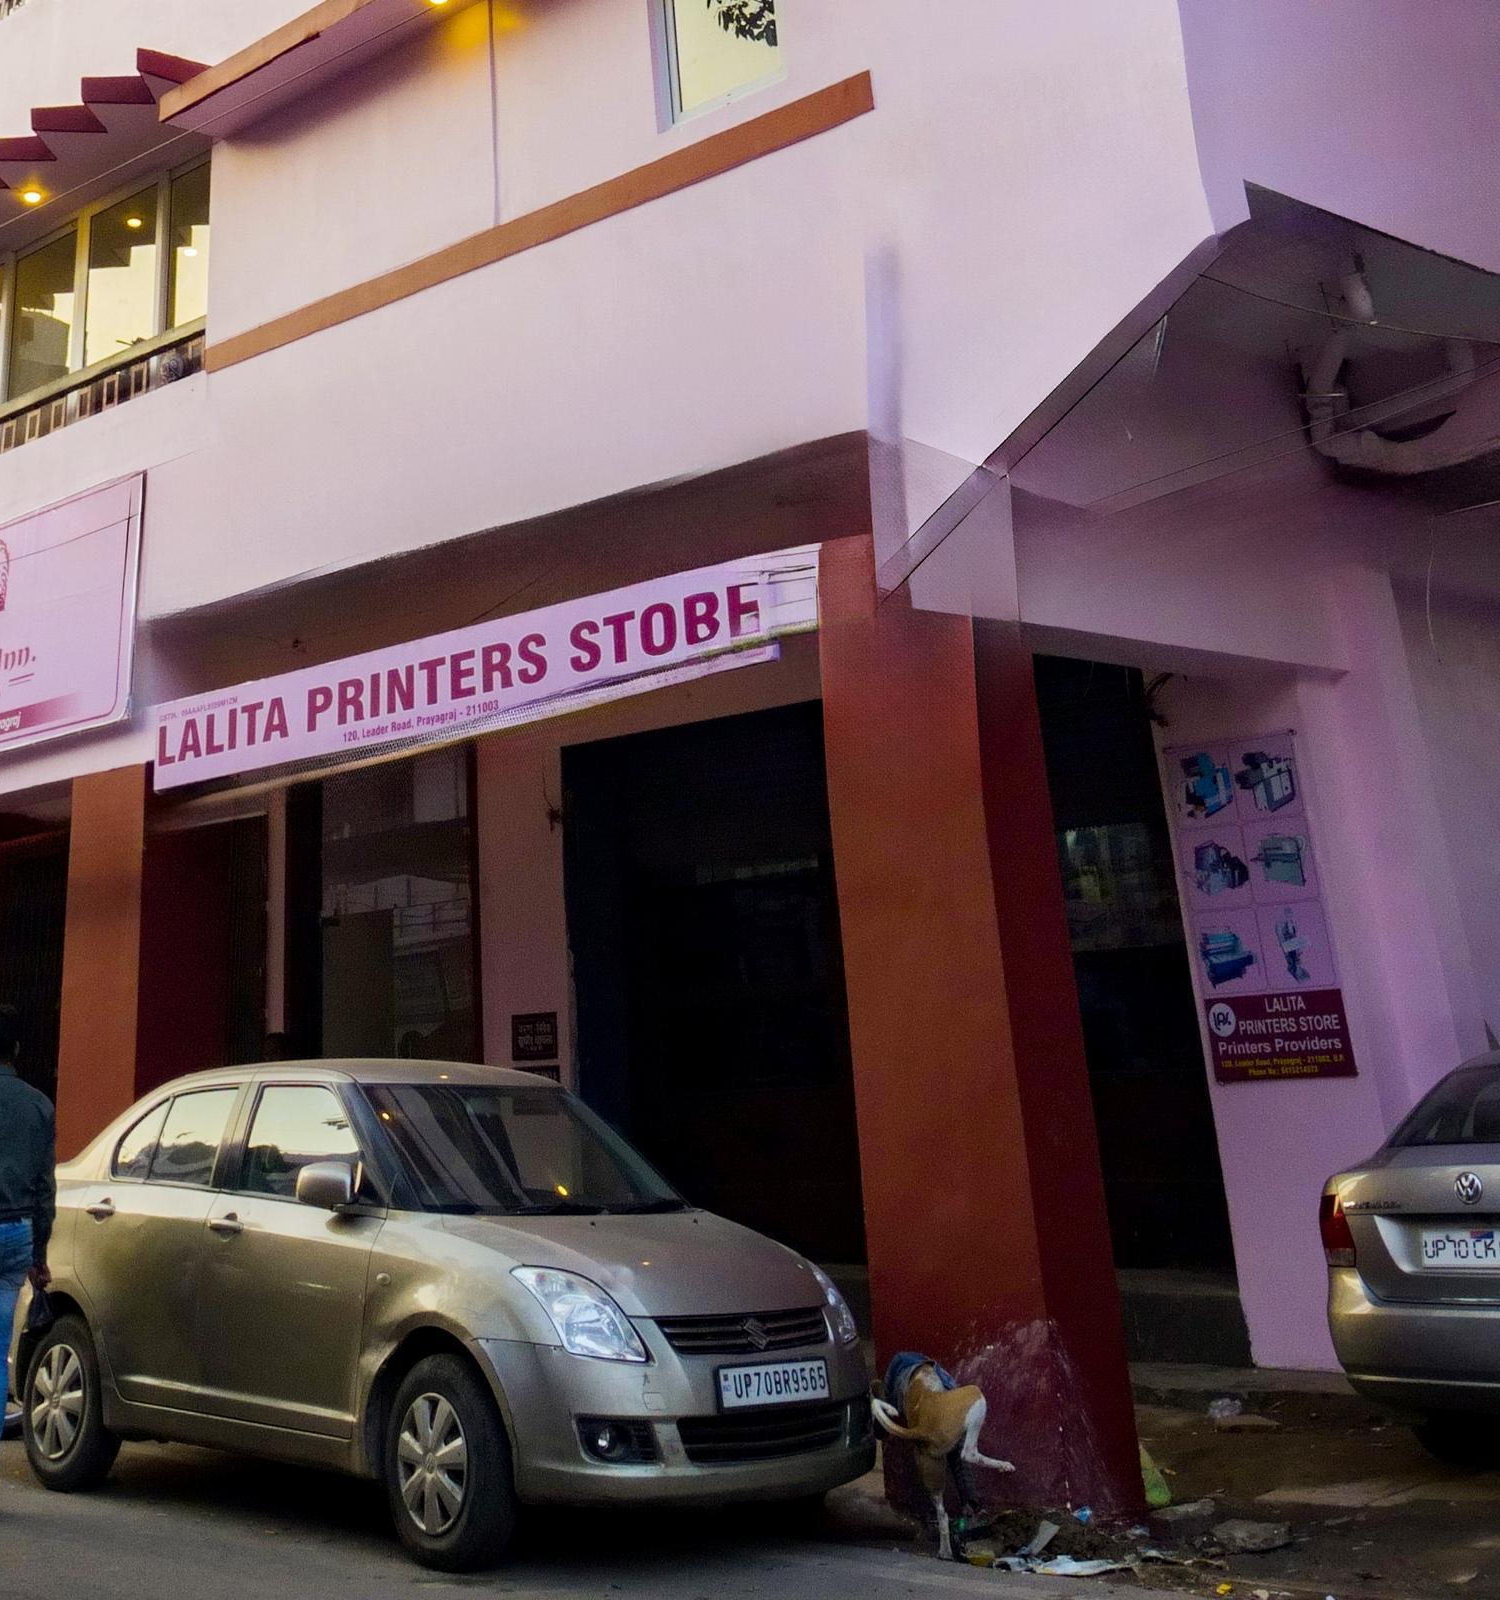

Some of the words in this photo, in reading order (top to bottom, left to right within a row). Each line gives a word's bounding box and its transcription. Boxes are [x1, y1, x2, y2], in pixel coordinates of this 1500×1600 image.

[158, 697, 289, 767] LALITA
[307, 633, 548, 732] PRINTERS
[362, 723, 388, 739] Leader
[391, 719, 413, 733] Road,
[417, 709, 457, 728] Prayagraj
[466, 699, 499, 717] 211003
[1265, 996, 1306, 1012] LALITA
[1239, 1018, 1297, 1035] PRINTERS
[1300, 1014, 1340, 1031] STORE
[1218, 1041, 1272, 1056] Printers
[1275, 1037, 1342, 1051] Providers
[733, 1367, 826, 1399] UP70BR9565
